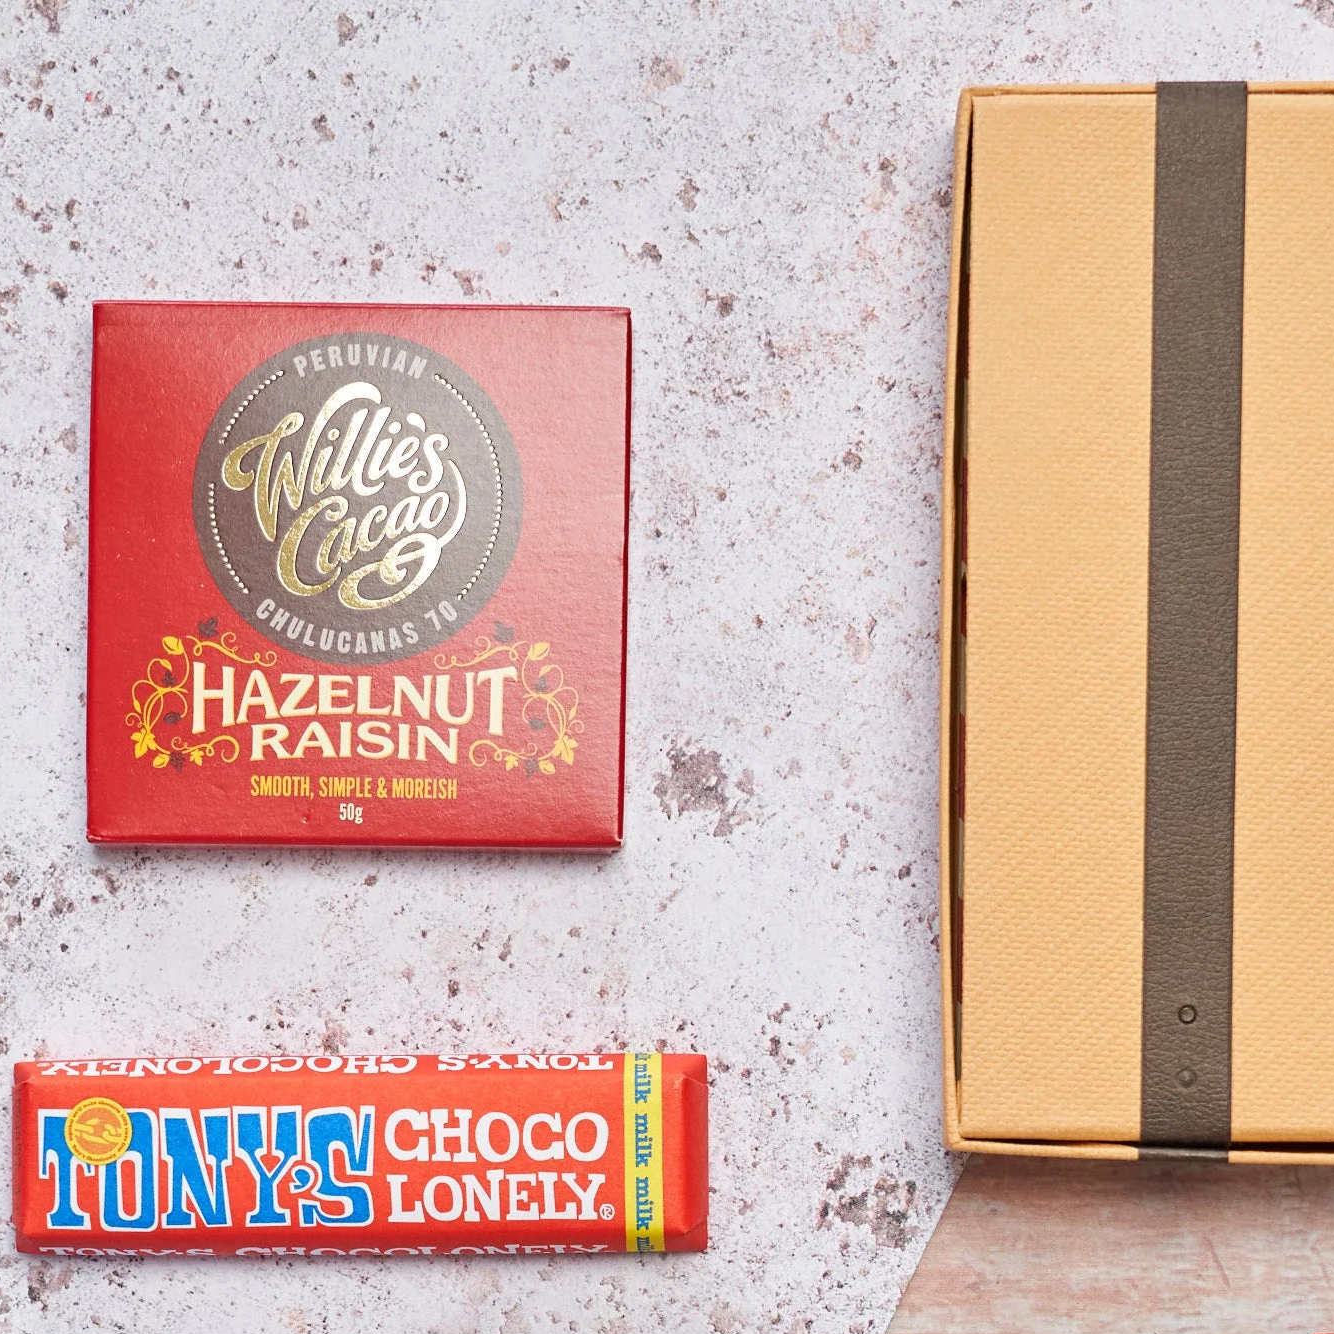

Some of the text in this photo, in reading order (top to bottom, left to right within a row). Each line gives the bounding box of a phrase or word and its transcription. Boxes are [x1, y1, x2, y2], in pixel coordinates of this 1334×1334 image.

[293, 343, 428, 379] PERUVIAN
[277, 465, 466, 609] Cacao
[256, 598, 458, 654] CHULUCANAS 70
[192, 661, 519, 736] HAZELNUT
[250, 721, 459, 765] RAISIN
[250, 775, 458, 800] SMOOTH, SIMPLE & MOREISH
[339, 803, 363, 824] 50g
[634, 1063, 652, 1104] milk
[385, 1109, 609, 1162] CHOCO
[635, 1113, 653, 1168] milk
[38, 1105, 375, 1233] TONY'S
[636, 1177, 654, 1231] milk
